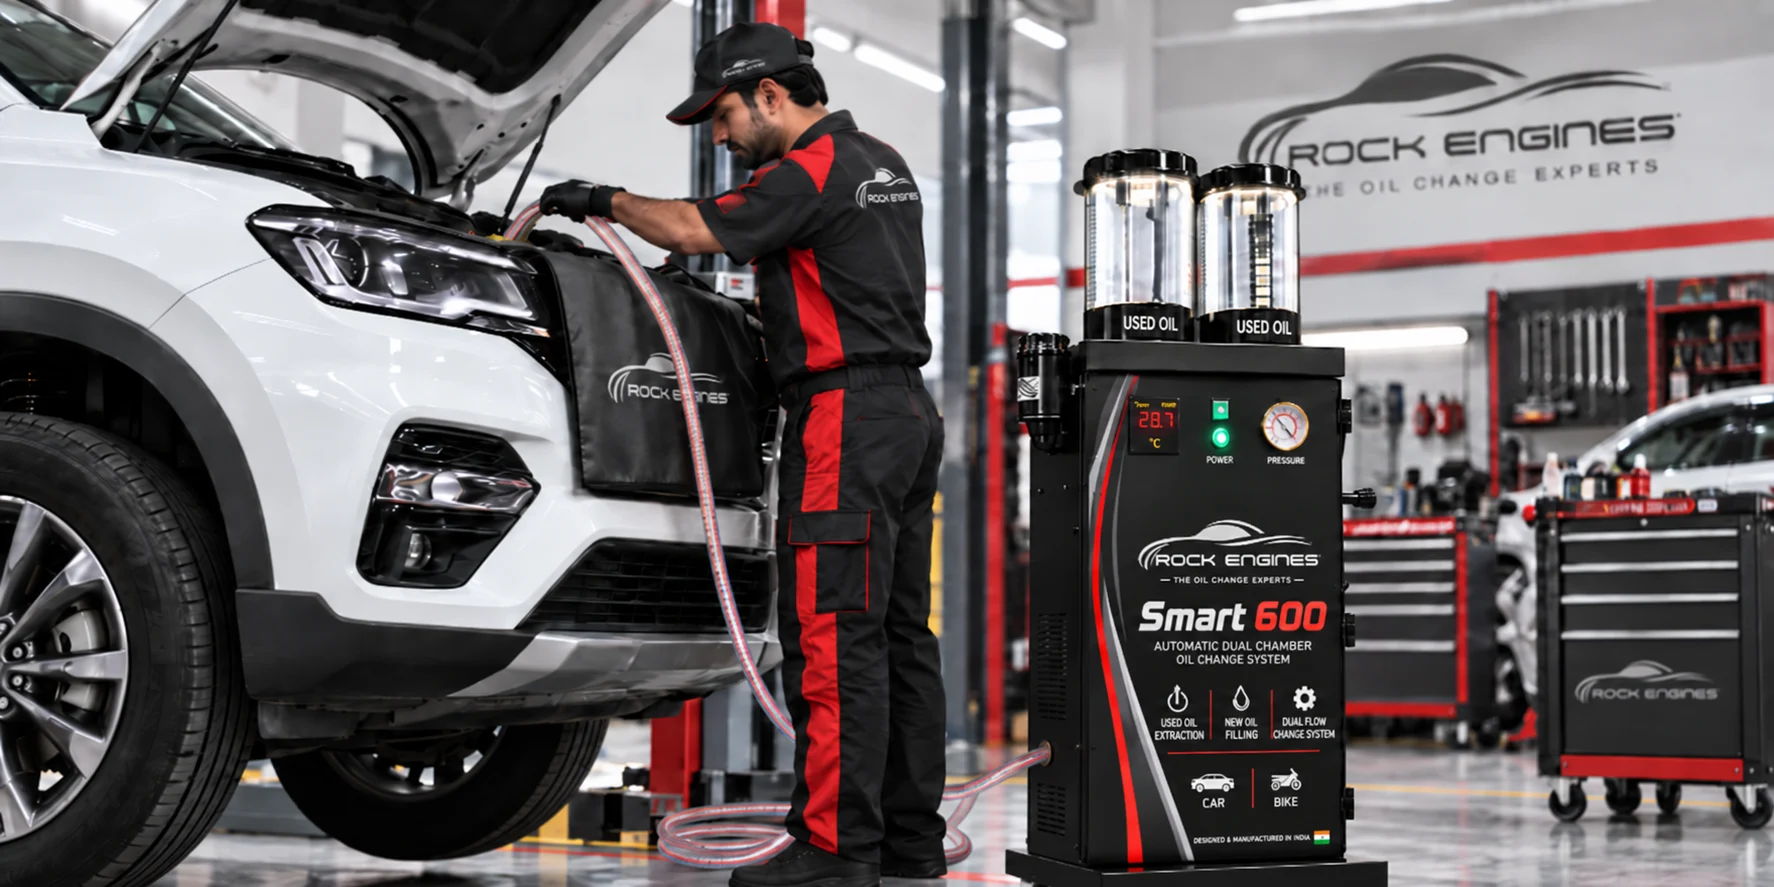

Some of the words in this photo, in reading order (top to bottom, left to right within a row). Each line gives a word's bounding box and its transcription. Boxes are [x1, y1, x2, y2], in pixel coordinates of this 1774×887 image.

[1287, 136, 1427, 167] ROCK
[1443, 114, 1676, 158] ENGINES
[1360, 180, 1400, 195] OIL
[1414, 170, 1517, 191] CHANGE
[1535, 159, 1660, 182] EXPERTS
[868, 193, 890, 203] ROCK
[1123, 315, 1155, 331] USED
[1158, 316, 1179, 332] OIL
[1236, 319, 1269, 334] USED
[1272, 320, 1292, 335] OIL
[627, 384, 671, 400] ROCK
[1138, 411, 1174, 429] 28.7
[1206, 455, 1234, 464] POWER
[1267, 456, 1306, 465] PRESSURE
[1155, 554, 1216, 567] ROCK
[1225, 554, 1319, 567] ENGINES
[1174, 576, 1191, 584] THE
[1193, 576, 1209, 584] OIL
[1211, 576, 1249, 584] CHANGE
[1252, 576, 1292, 584] EXPERTS
[1138, 601, 1247, 632] Smart
[1254, 601, 1328, 632] 600
[1154, 641, 1219, 651] AUTOMATIC
[1222, 641, 1252, 651] DUAL
[1255, 641, 1312, 651] CHAMBER
[1176, 654, 1194, 665] OIL
[1197, 654, 1244, 665] CHANGE
[1247, 654, 1291, 665] SYSTEM
[1591, 688, 1641, 701] ROCK
[1645, 687, 1718, 701] ENGINES
[1161, 718, 1182, 728] USED
[1184, 718, 1198, 727] OIL
[1224, 718, 1243, 727] NEW
[1245, 717, 1258, 727] OIL
[1282, 717, 1303, 727] DUAL
[1305, 717, 1327, 726] FLOW
[1154, 730, 1205, 740] EXTRACTION
[1225, 730, 1259, 740] FILLING
[1273, 730, 1305, 740] CHANGE
[1306, 729, 1336, 739] SYSTEM
[1202, 797, 1225, 809] CAR
[1274, 796, 1299, 807] BIKE
[1193, 836, 1225, 844] DESIGNED
[1232, 835, 1283, 843] MANUFACTURED
[1293, 834, 1310, 842] INDIA
